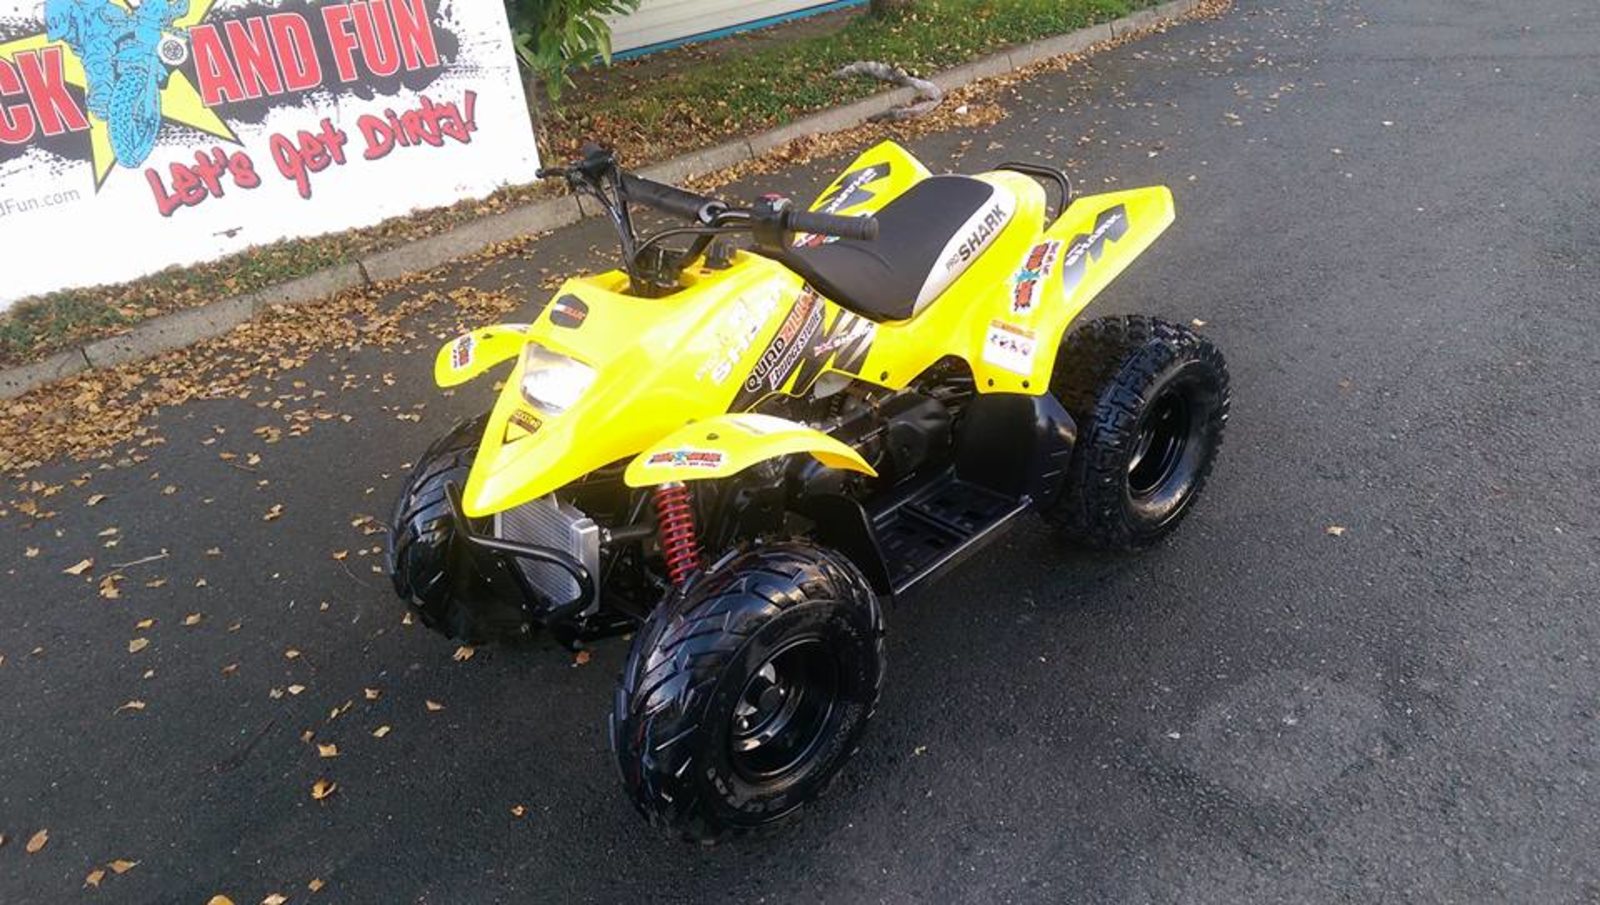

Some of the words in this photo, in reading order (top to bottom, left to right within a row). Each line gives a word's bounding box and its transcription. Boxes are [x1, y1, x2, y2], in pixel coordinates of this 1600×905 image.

[188, 13, 323, 107] AND
[321, 0, 440, 83] FUN
[145, 147, 261, 216] Let's
[958, 203, 1008, 262] SHARK
